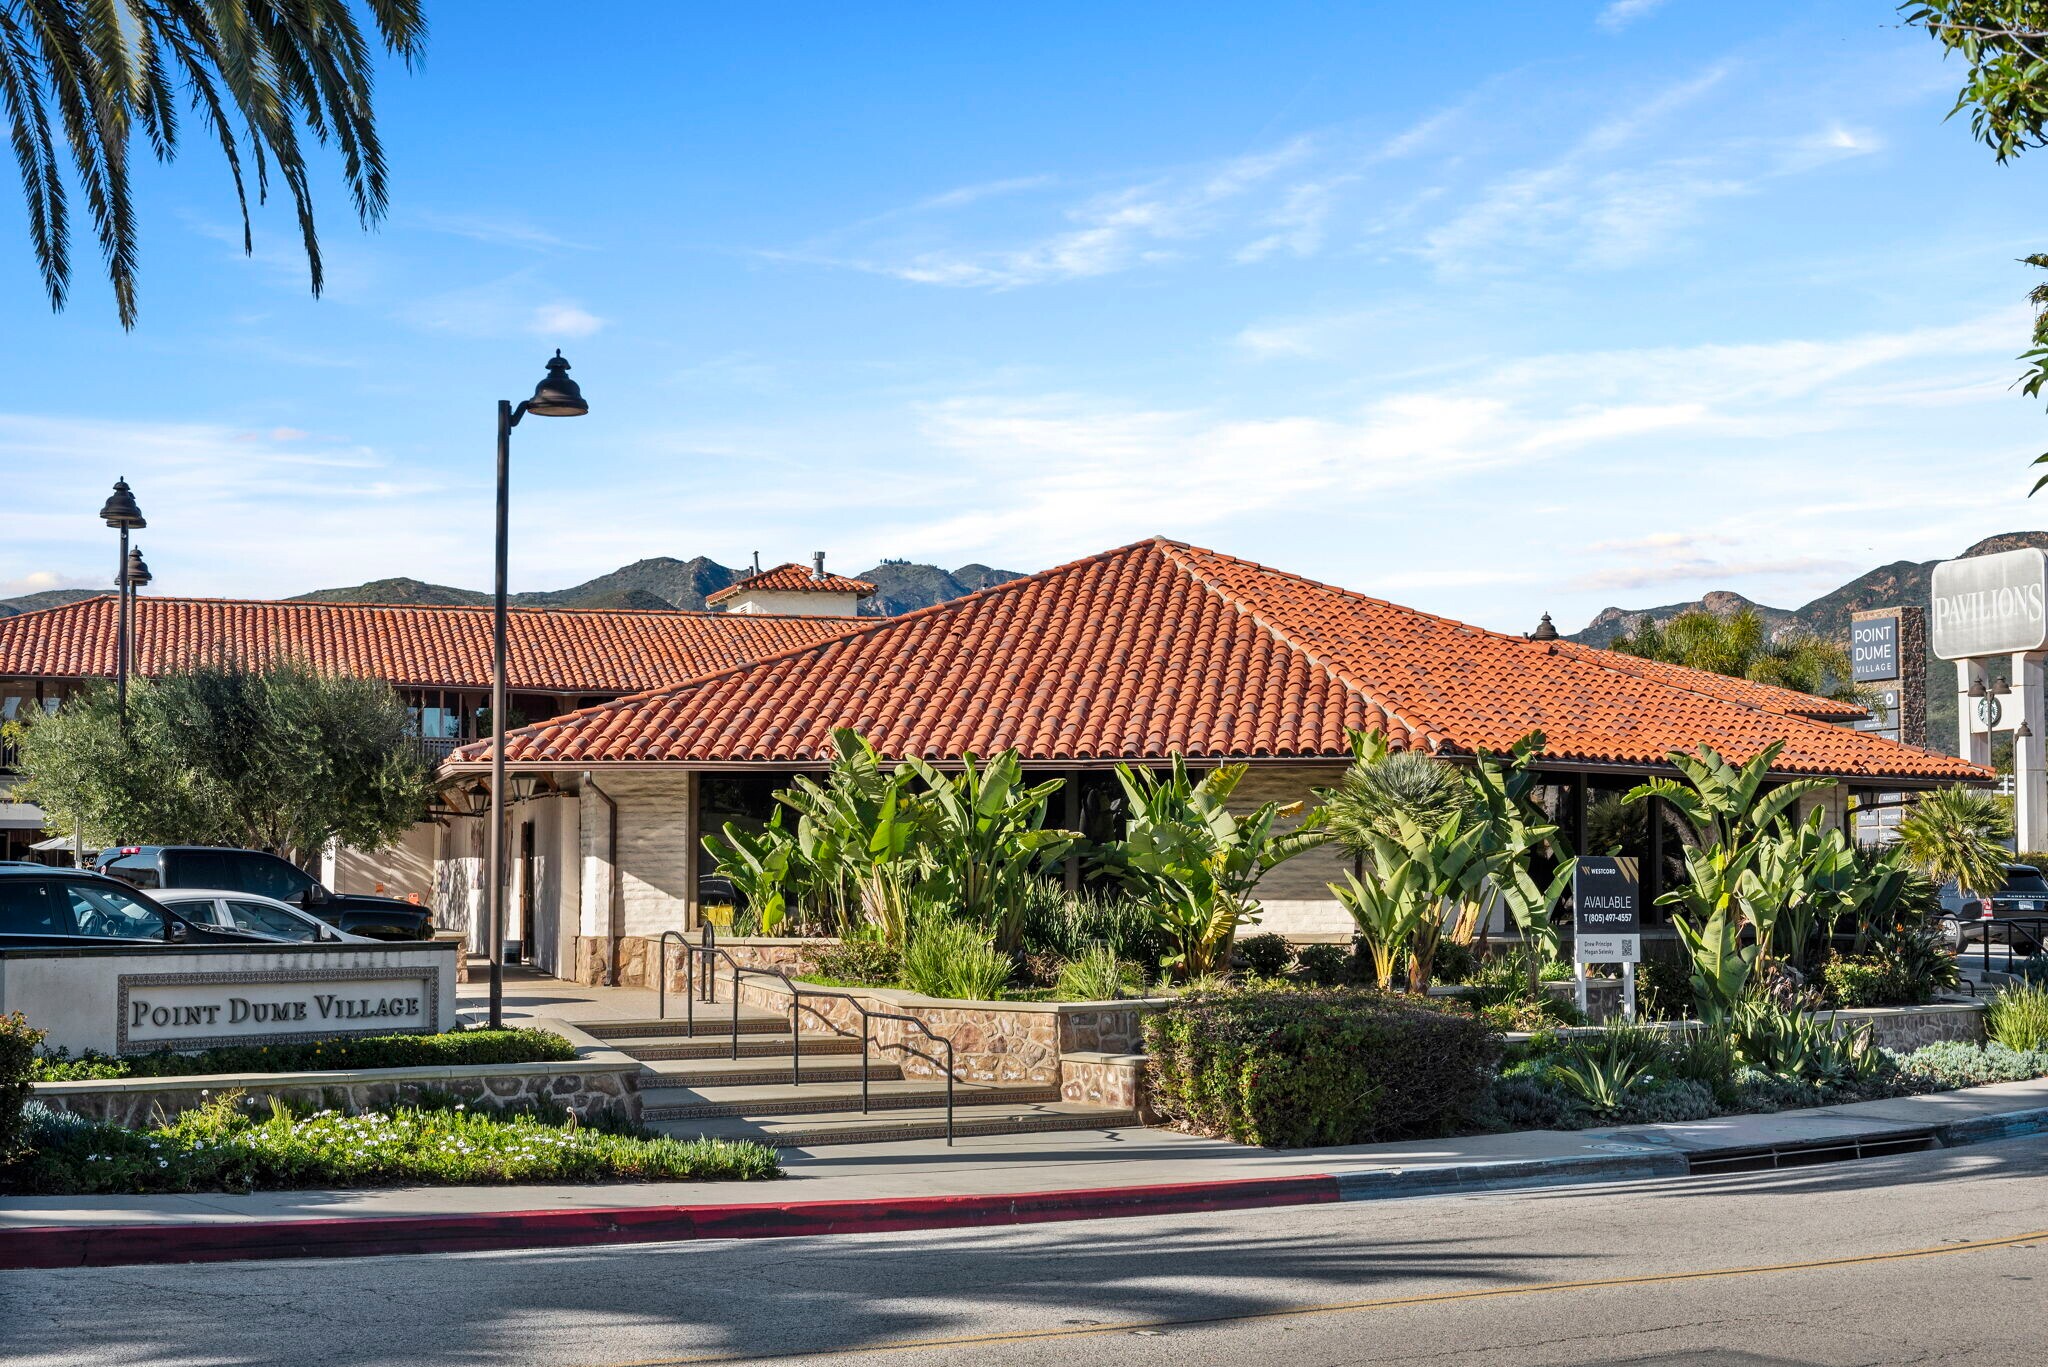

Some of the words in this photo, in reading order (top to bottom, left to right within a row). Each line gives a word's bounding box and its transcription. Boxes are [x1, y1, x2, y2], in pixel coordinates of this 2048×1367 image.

[1935, 583, 2043, 633] PAVILIONS
[1854, 625, 1891, 643] POINT
[1855, 644, 1891, 662] DUME
[1856, 662, 1892, 673] VILLAGE
[1584, 896, 1631, 908] AVAILABLE
[1583, 913, 1588, 922] T
[1589, 913, 1605, 924] (805)
[1605, 913, 1632, 922] 497-4557
[132, 1000, 221, 1027] POINT
[229, 998, 308, 1024] DUME
[314, 994, 420, 1019] VILLAGE
